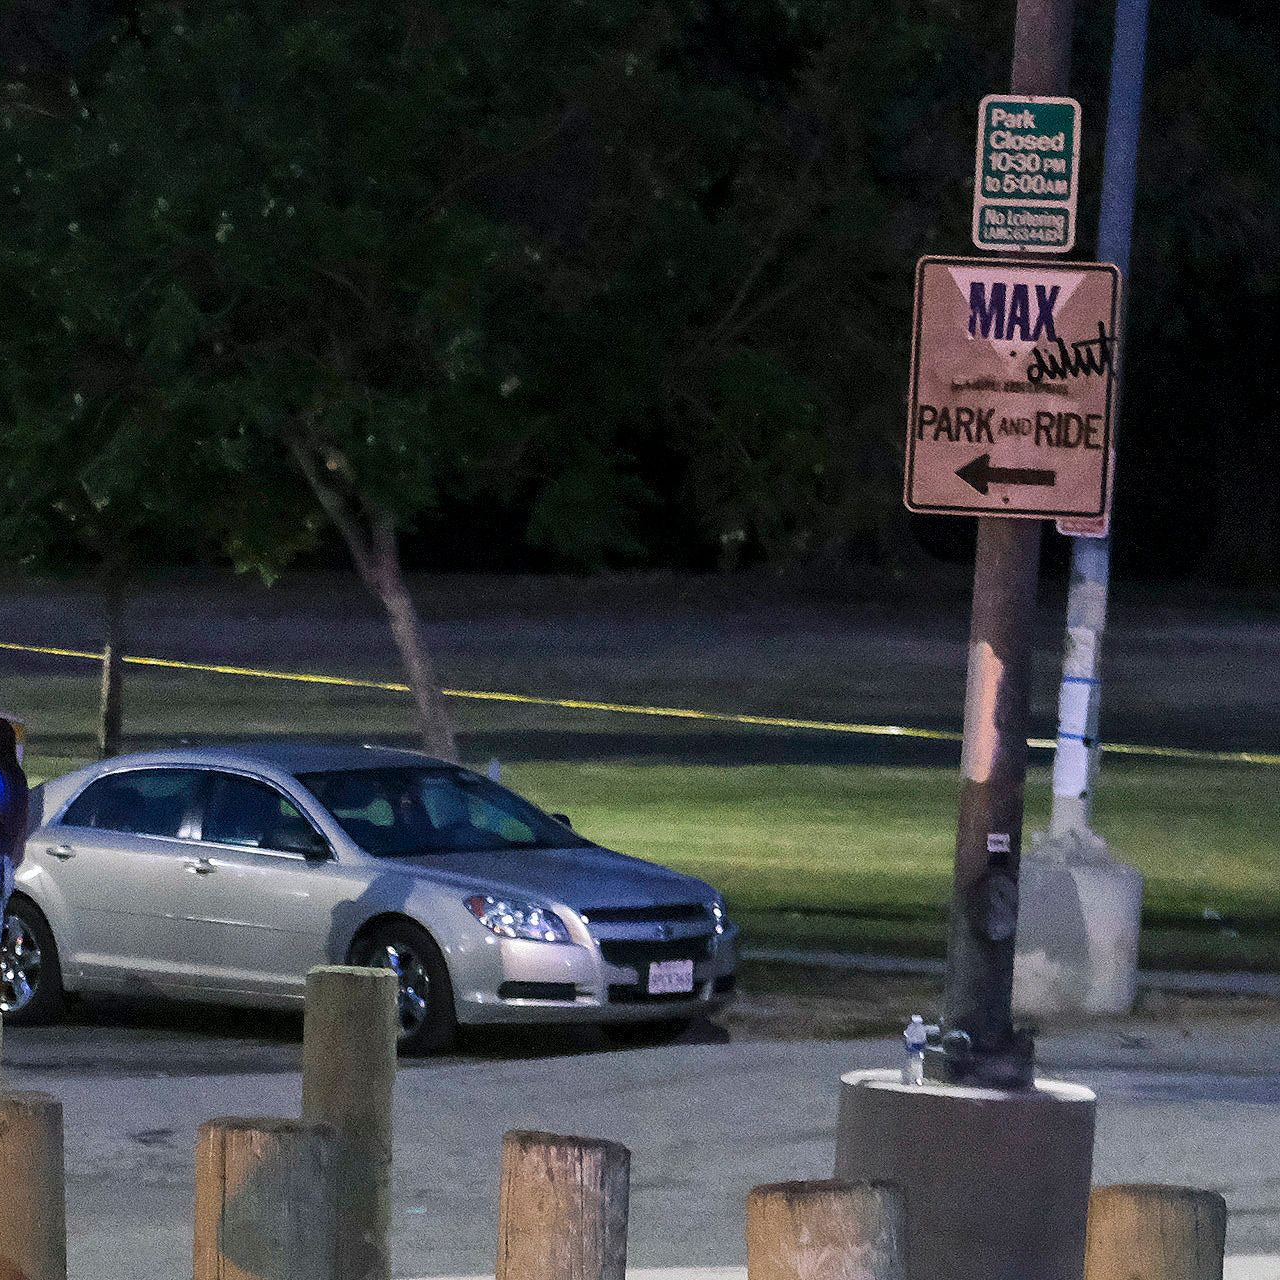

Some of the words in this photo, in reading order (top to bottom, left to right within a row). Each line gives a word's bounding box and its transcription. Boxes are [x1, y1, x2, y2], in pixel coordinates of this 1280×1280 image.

[991, 108, 1037, 129] Park
[989, 130, 1066, 152] Closed
[1042, 158, 1067, 174] PM
[985, 175, 1001, 192] to
[985, 208, 1006, 226] No
[968, 282, 1061, 342] MAX
[915, 404, 996, 445] PARK
[997, 417, 1033, 436] AND
[1033, 411, 1104, 450] RIDE
